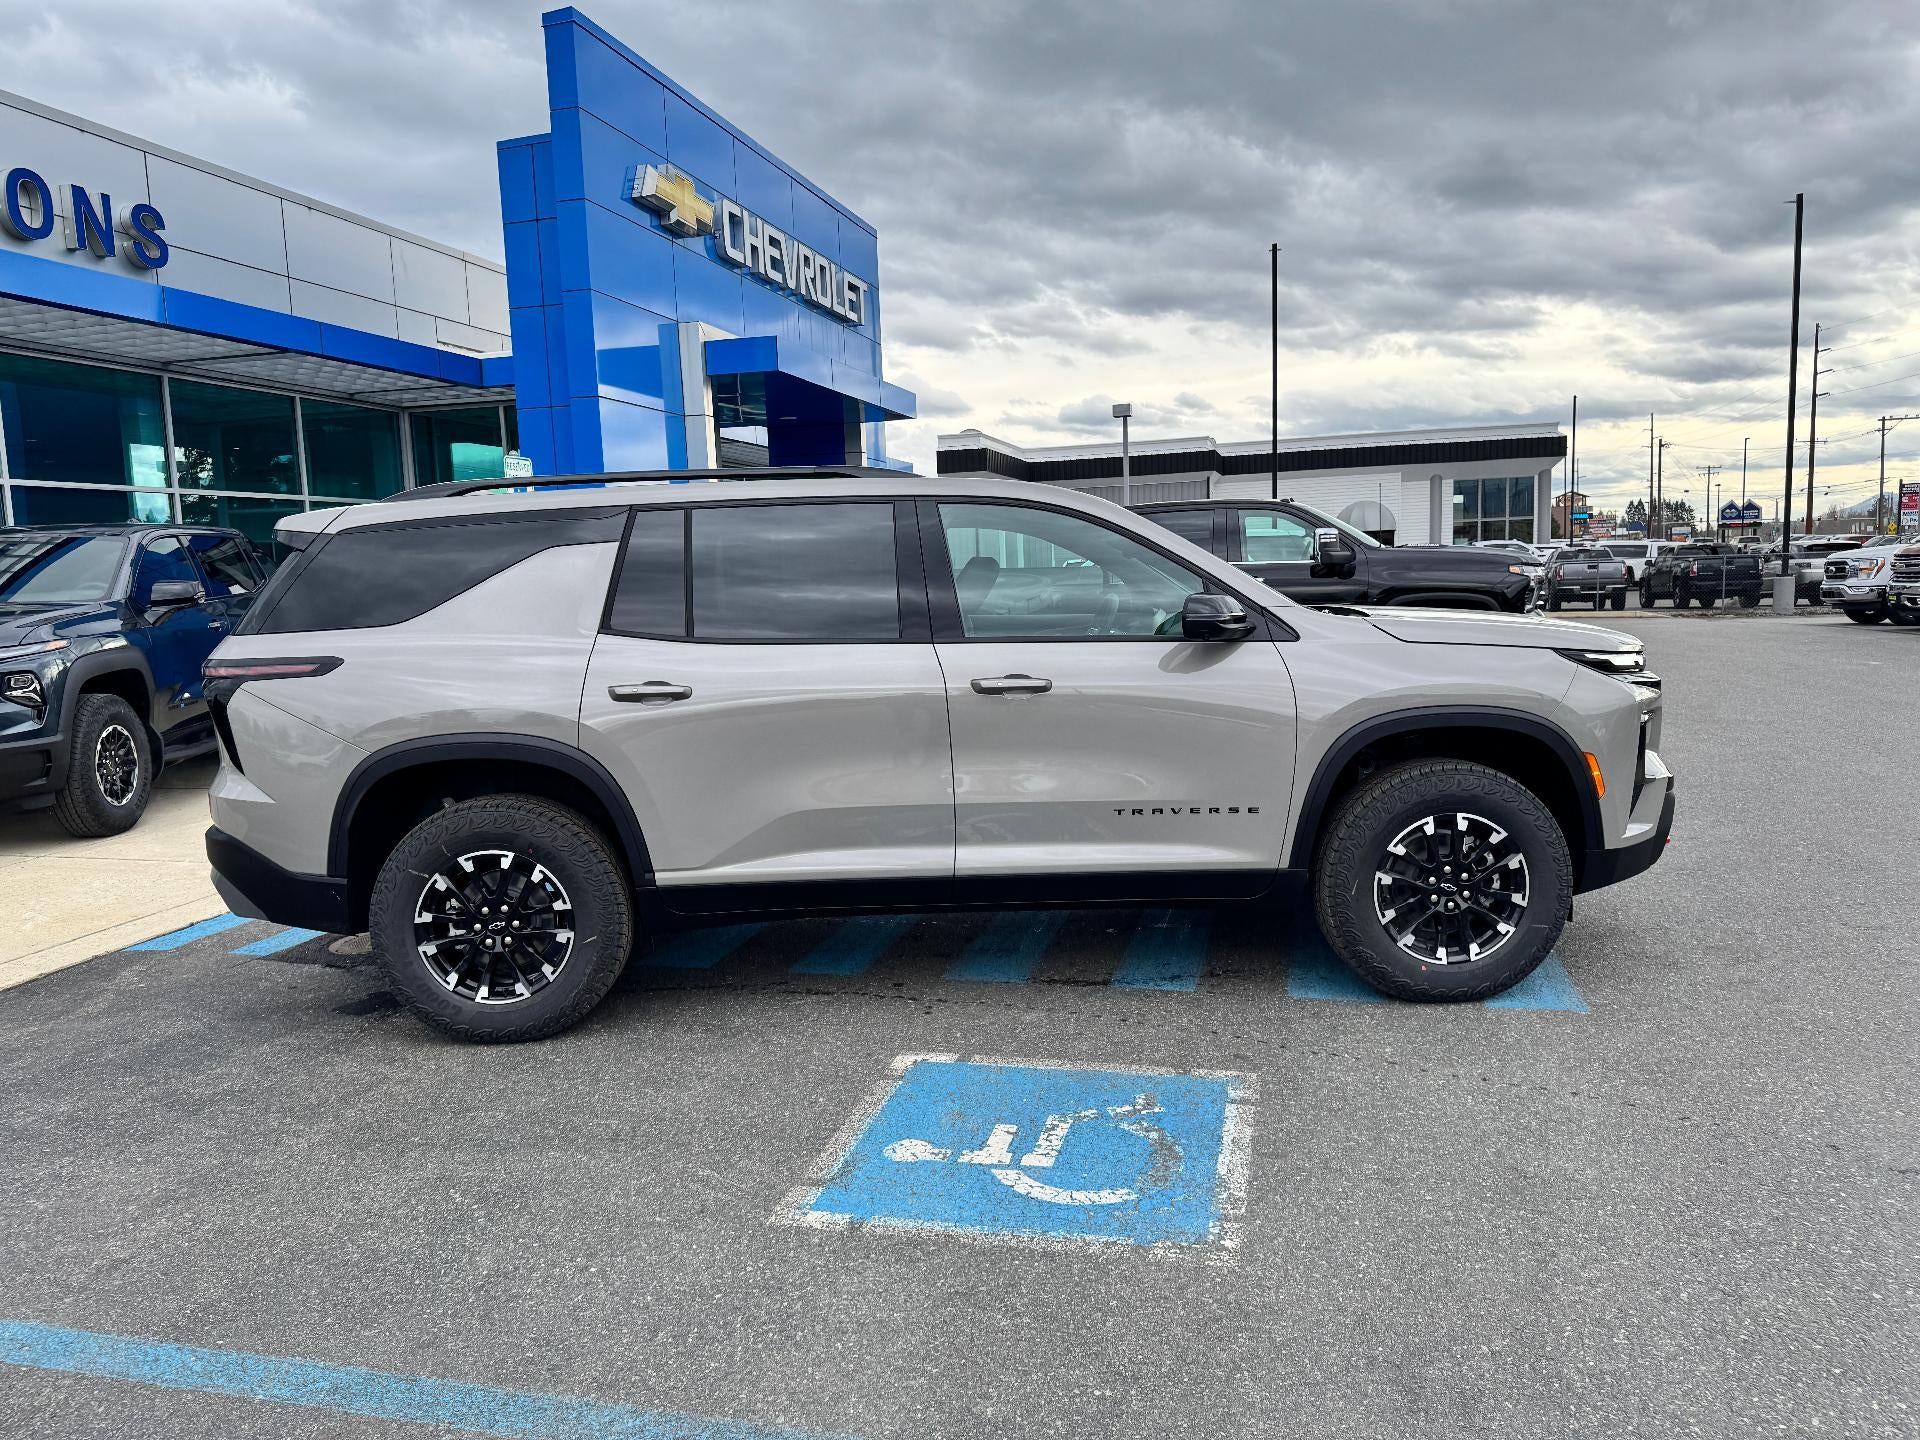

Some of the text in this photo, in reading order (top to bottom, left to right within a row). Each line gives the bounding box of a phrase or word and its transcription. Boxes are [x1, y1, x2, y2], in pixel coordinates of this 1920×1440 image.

[3, 167, 169, 269] ONS
[722, 199, 868, 326] CHEVROLET
[1113, 806, 1260, 816] TRAVERSE
